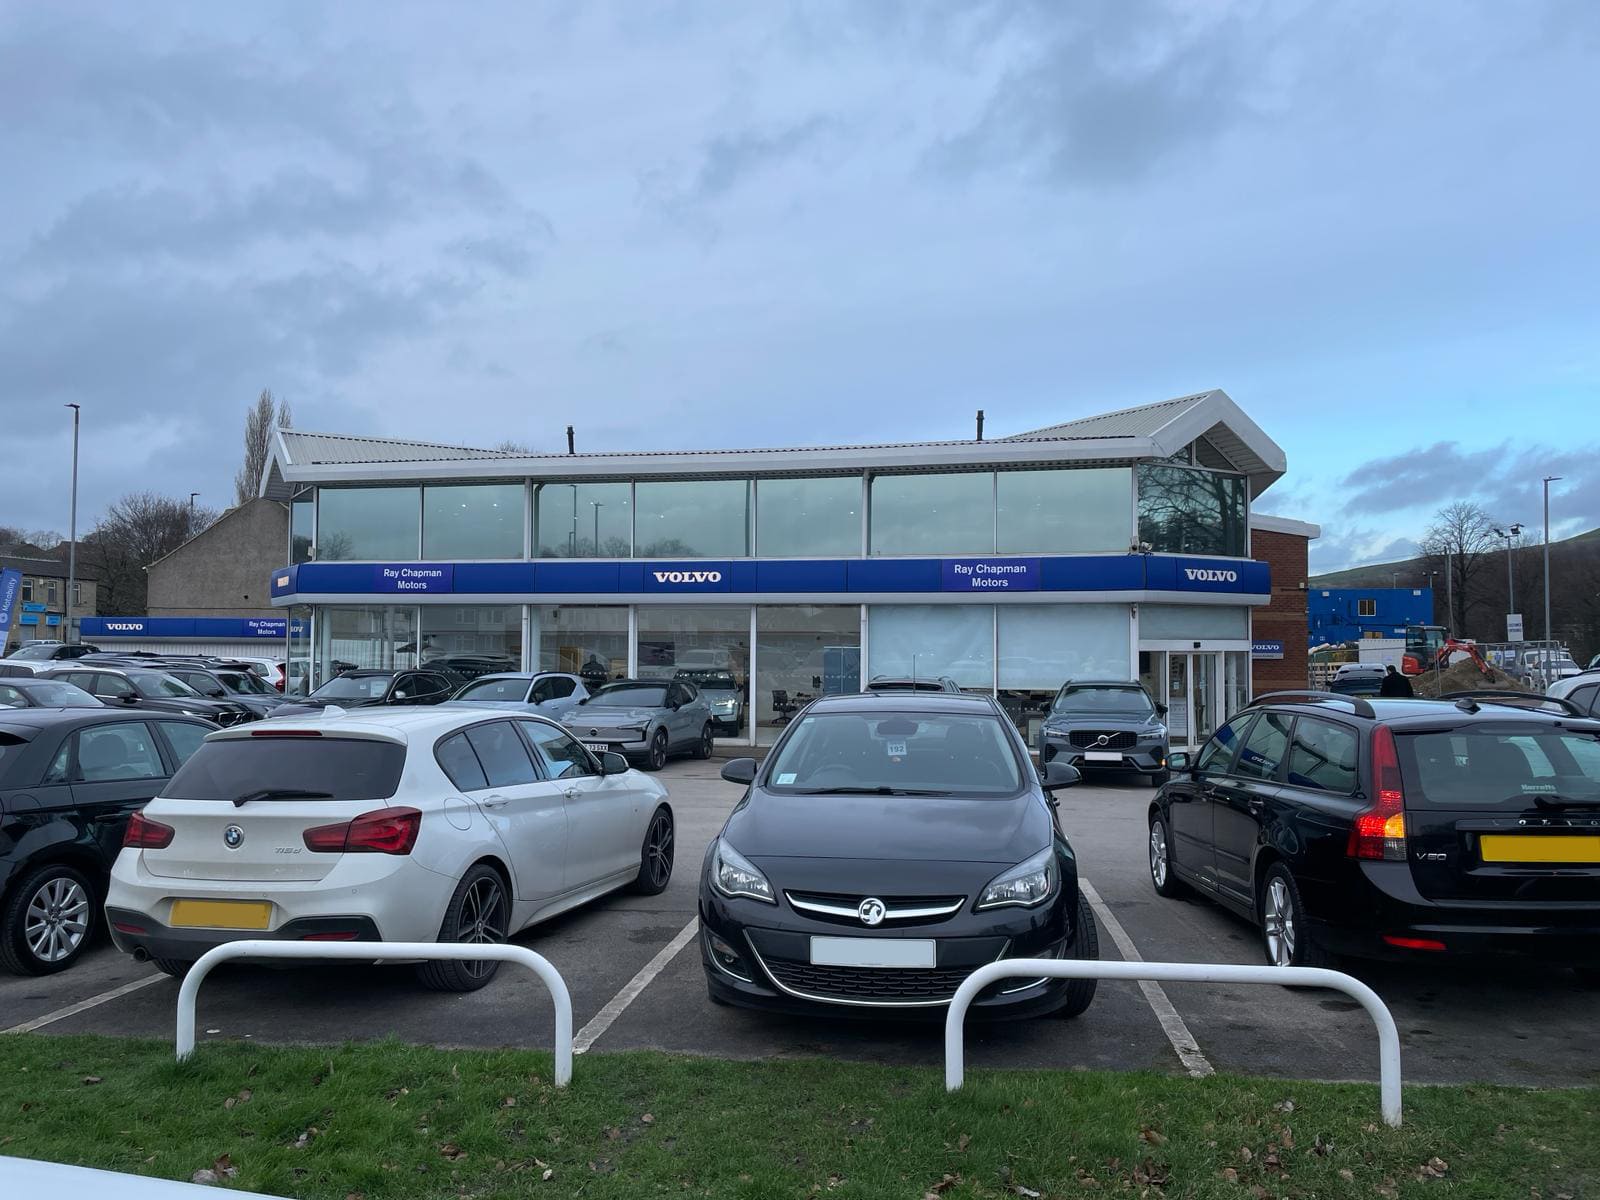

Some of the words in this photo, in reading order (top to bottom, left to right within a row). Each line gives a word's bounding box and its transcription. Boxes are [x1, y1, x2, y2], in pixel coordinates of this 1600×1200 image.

[383, 568, 399, 579] Ray
[401, 568, 442, 579] Chapman
[953, 564, 973, 575] Ray
[976, 564, 1027, 575] Chapman
[1184, 568, 1237, 582] VOLVO
[653, 571, 722, 583] VOLVO
[971, 577, 1009, 587] Motors
[397, 581, 427, 590] Motors
[2, 577, 17, 611] Motability
[106, 623, 143, 631] VOLVO
[889, 745, 905, 753] 192
